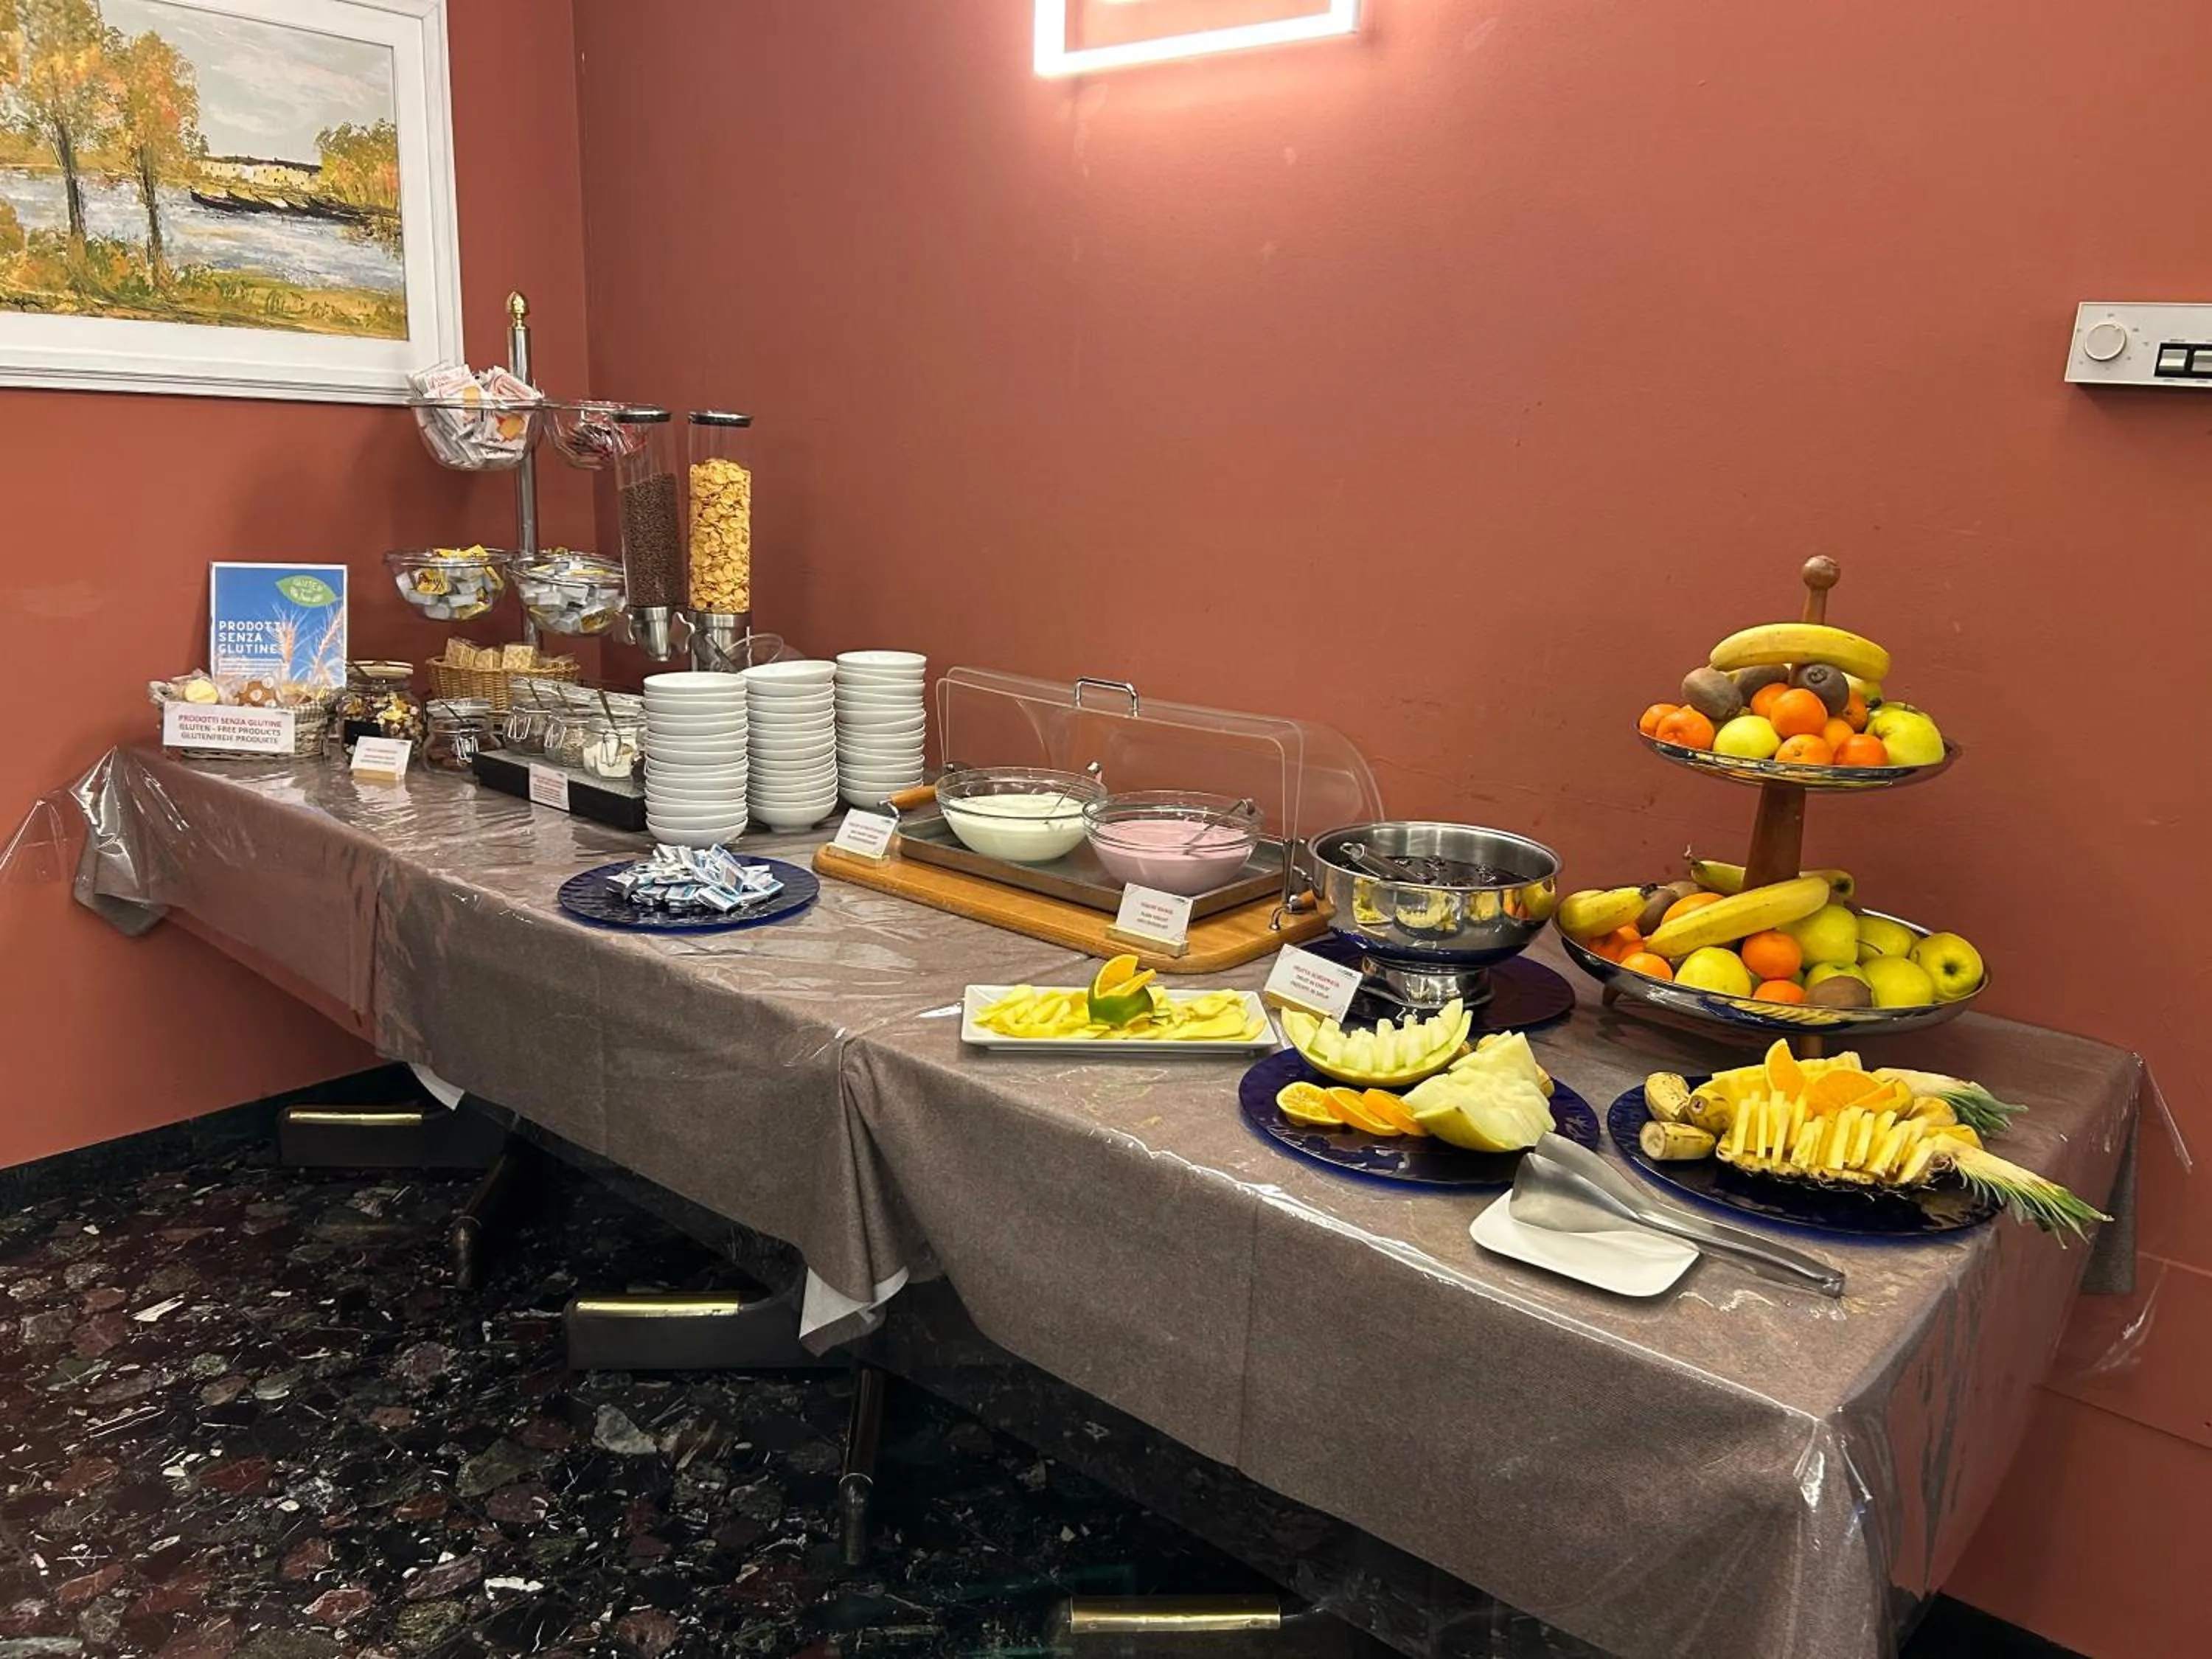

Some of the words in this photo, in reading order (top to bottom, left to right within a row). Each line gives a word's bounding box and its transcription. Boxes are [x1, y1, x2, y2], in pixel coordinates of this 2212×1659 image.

[219, 633, 262, 642] SENZA
[219, 644, 277, 654] GLUTINE
[178, 715, 219, 724] PRODOTTI
[221, 717, 246, 726] SENZA
[248, 720, 282, 728] GLUTINE
[179, 723, 210, 731] GLUTEN
[218, 726, 236, 734] FREE
[238, 728, 281, 737] PRODUCTS
